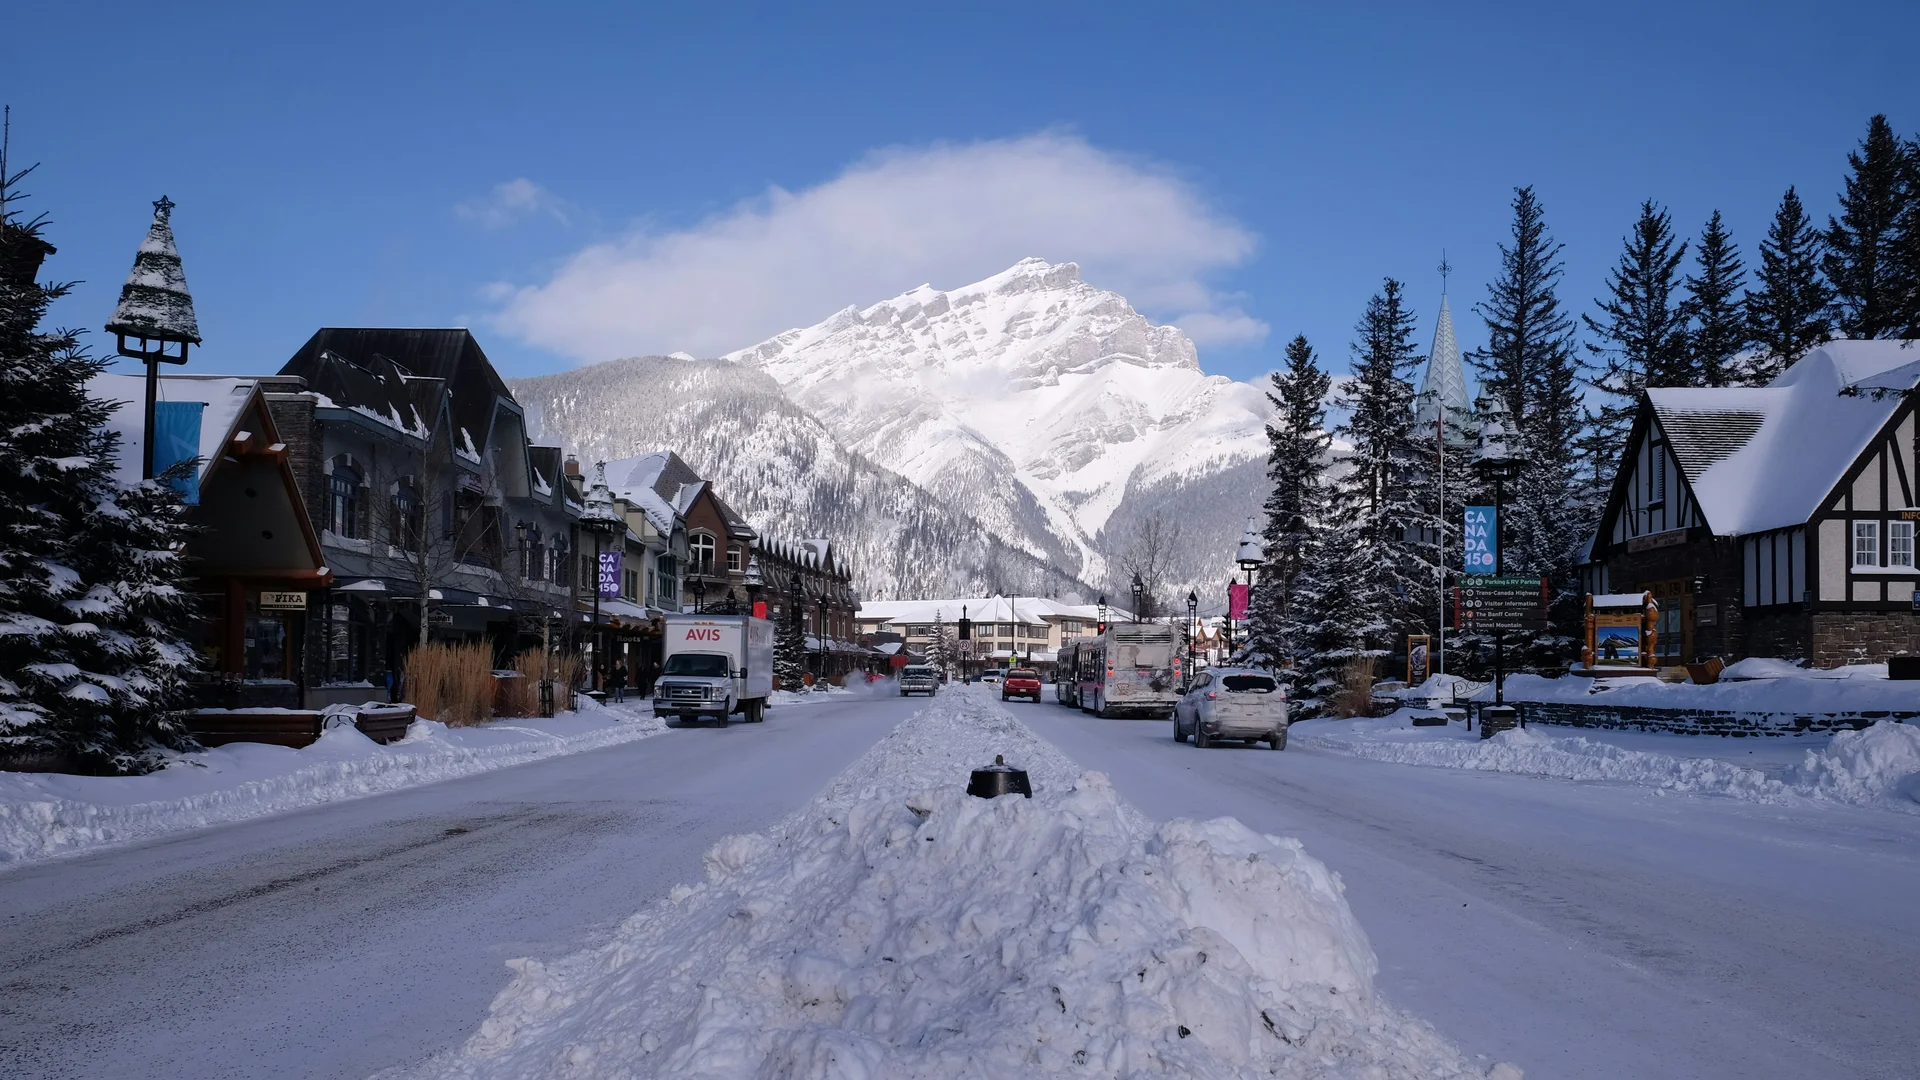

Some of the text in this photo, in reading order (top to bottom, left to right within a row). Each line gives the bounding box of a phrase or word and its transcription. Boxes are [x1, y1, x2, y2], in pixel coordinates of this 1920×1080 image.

[1464, 510, 1487, 523] CA
[1464, 524, 1487, 537] NA
[1464, 538, 1487, 551] DA
[599, 554, 614, 563] CA
[1464, 552, 1494, 566] 150
[599, 563, 614, 573] NA
[599, 573, 614, 582] DA
[275, 594, 303, 603] PIKA
[616, 635, 641, 643] Roots
[685, 628, 720, 641] AVIS
